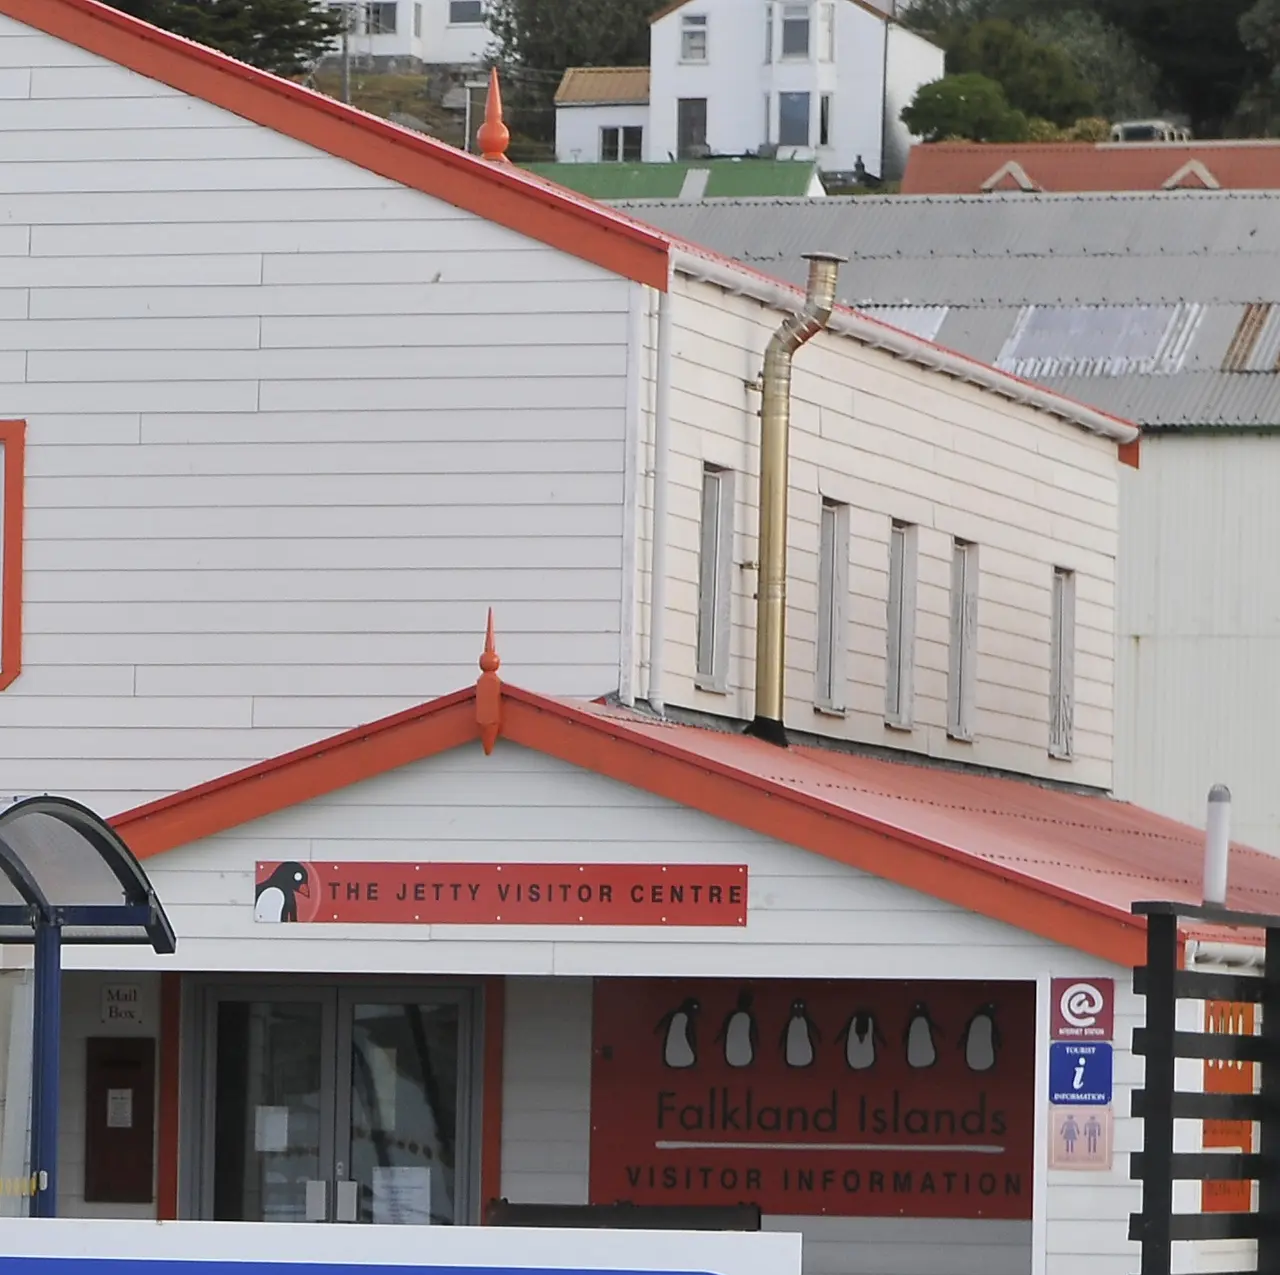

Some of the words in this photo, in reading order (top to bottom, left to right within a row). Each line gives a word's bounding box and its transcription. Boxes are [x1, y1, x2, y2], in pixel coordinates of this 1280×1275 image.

[328, 882, 379, 901] THE
[396, 883, 481, 902] JETTY
[497, 883, 613, 904] VISITOR
[630, 885, 741, 905] CENTRE
[107, 988, 137, 1002] Mail
[108, 1005, 136, 1019] Box
[1065, 1046, 1096, 1055] TOURIST
[1053, 1092, 1106, 1101] INFORMATION
[656, 1088, 838, 1133] Falkland
[857, 1090, 1008, 1136] Islands
[626, 1165, 762, 1191] VISITOR
[783, 1168, 1021, 1196] INFORMATION
